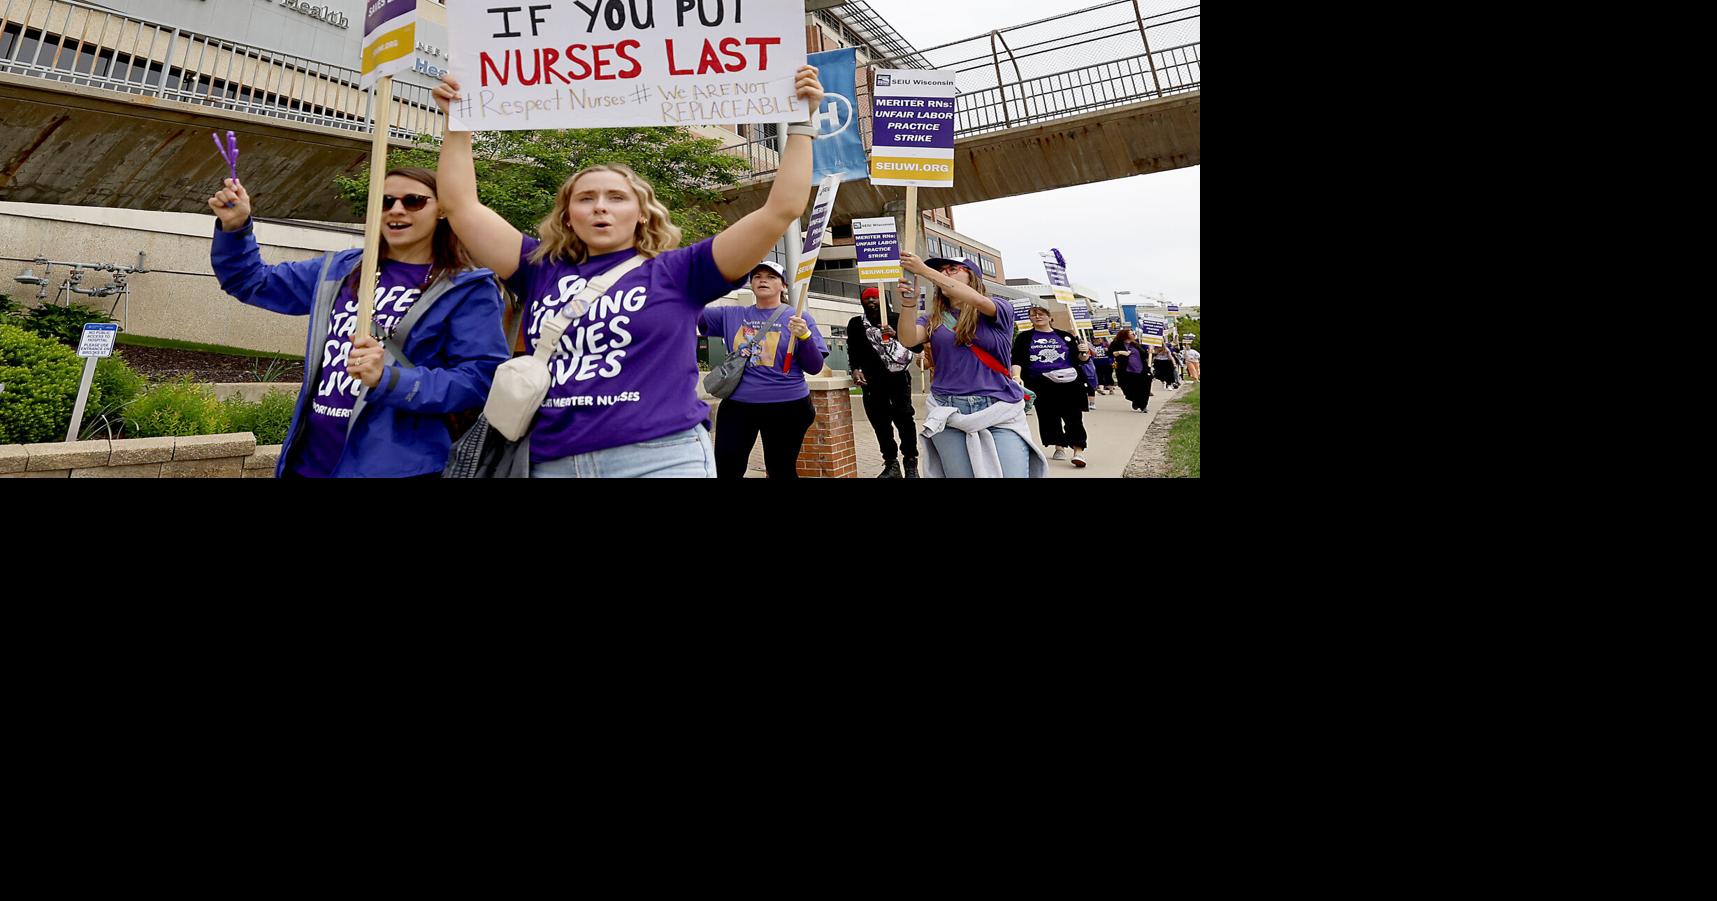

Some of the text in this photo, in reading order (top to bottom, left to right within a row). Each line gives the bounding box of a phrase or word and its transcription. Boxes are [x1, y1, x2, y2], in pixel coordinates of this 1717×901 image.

[487, 0, 743, 38] IF YOU PUT
[480, 37, 781, 87] NURSES LAST
[569, 88, 626, 111] Nurses
[876, 99, 953, 108] MERITER RNs:
[660, 95, 800, 123] REPLACEABLE
[875, 111, 953, 120] UNFAIR LABOR
[887, 122, 941, 131] PRACTICE
[894, 134, 933, 142] STRIKE
[876, 162, 949, 172] SEIUWI.ORG
